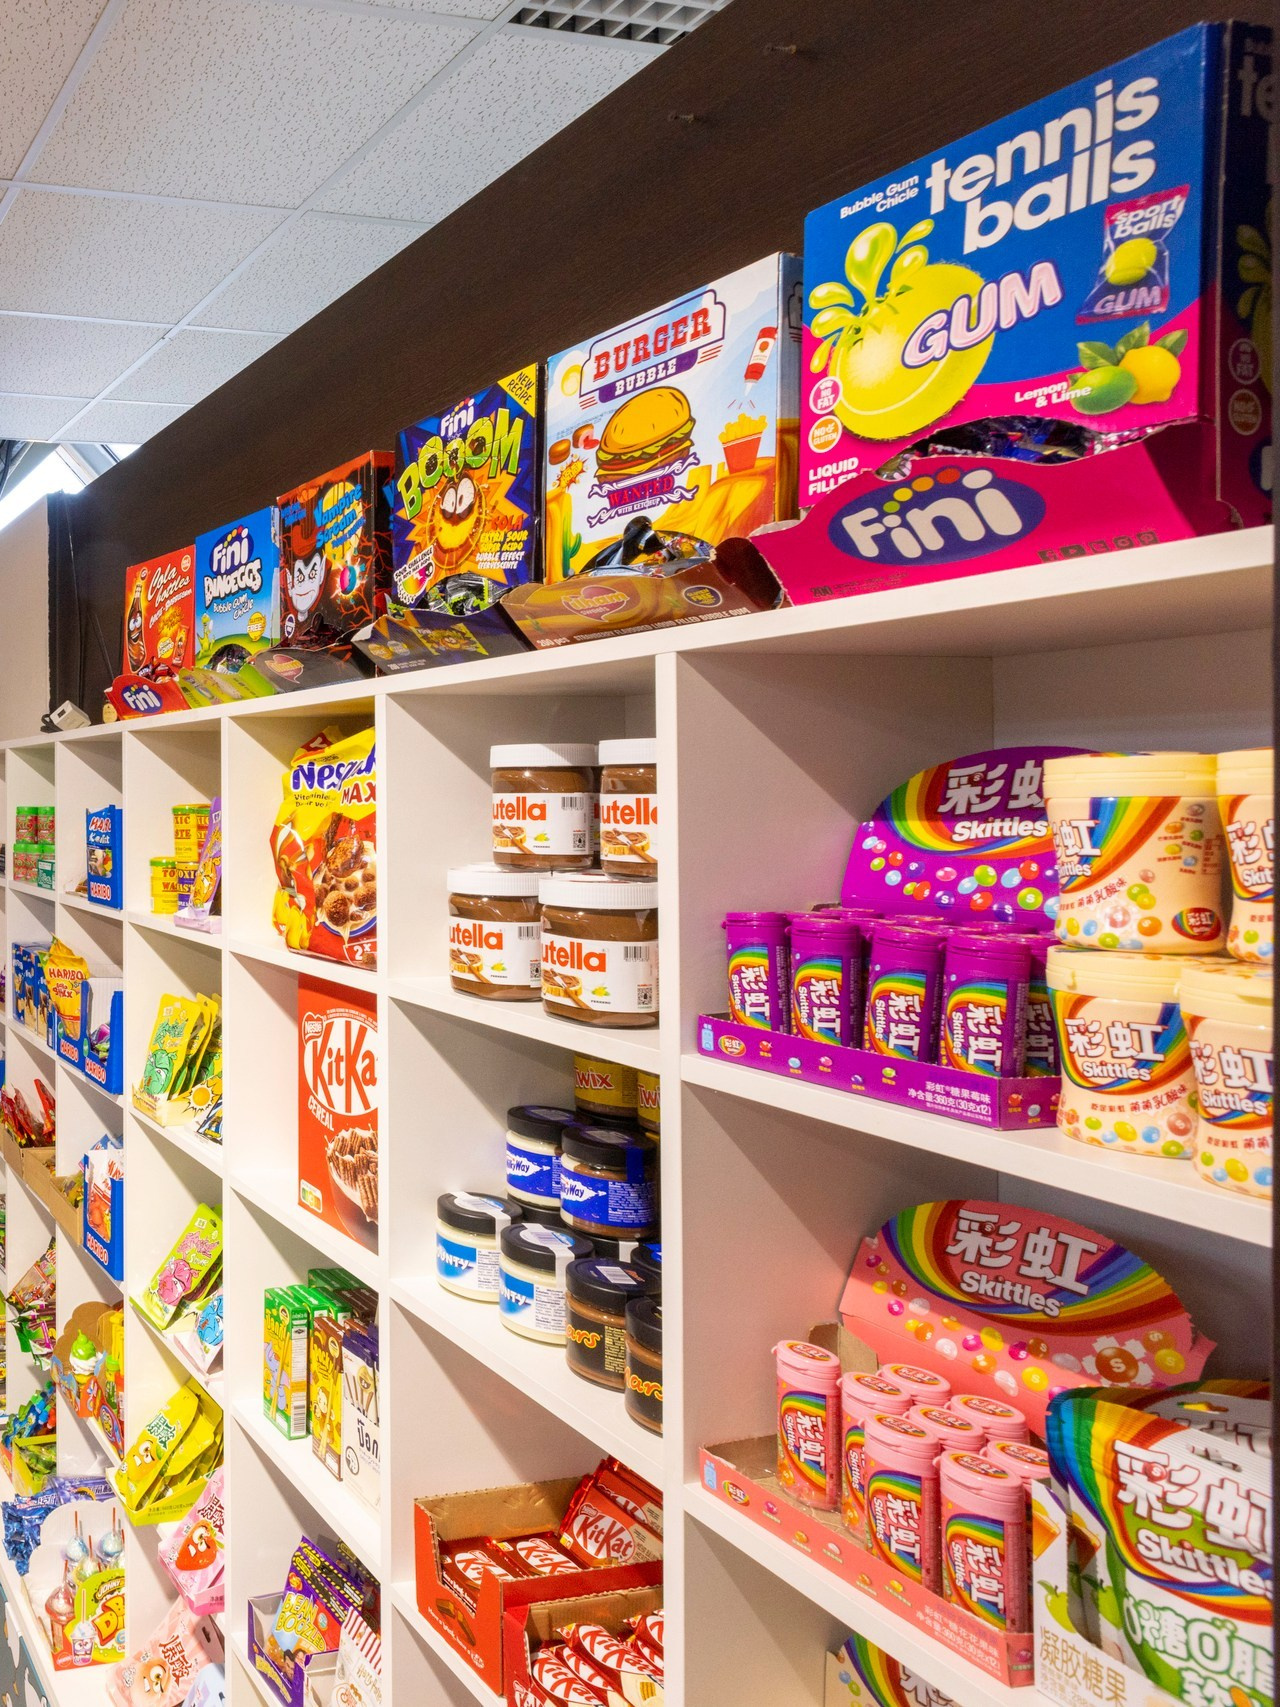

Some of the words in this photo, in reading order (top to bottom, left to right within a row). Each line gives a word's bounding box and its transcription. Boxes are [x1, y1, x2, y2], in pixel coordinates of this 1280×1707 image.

[925, 77, 1160, 215] tennis
[840, 190, 884, 219] Bubble
[886, 174, 919, 199] Gum
[876, 187, 920, 214] Chicle
[963, 140, 1158, 255] balls
[1111, 195, 1185, 226] sport
[1114, 212, 1179, 240] balls
[901, 261, 1064, 368] GUM
[1093, 285, 1161, 315] GUM
[593, 306, 713, 380] BURGER
[507, 380, 532, 405] RECIPE
[516, 370, 534, 391] NEW
[614, 360, 678, 397] BUBBLE
[820, 388, 832, 398] NO
[1014, 381, 1068, 404] Lemon
[1035, 395, 1048, 408] &
[1051, 385, 1092, 405] Lime
[440, 399, 475, 437] Fini
[817, 397, 835, 409] FAT
[813, 433, 838, 446] GLUTEN
[808, 457, 859, 481] LIQUID
[313, 484, 362, 528] Vampire
[607, 475, 676, 508] WANTED
[617, 504, 635, 516] WITH
[316, 509, 357, 548] Scream
[841, 469, 1022, 560] Fini
[213, 526, 249, 574] Fini
[481, 531, 505, 542] EXTRA
[506, 530, 528, 541] SOUR
[394, 564, 407, 579] SOUR
[408, 547, 433, 570] CHALLENGE
[500, 551, 525, 561] EFFECT
[148, 563, 177, 601] Cola
[155, 575, 190, 608] bottles
[247, 623, 263, 633] FREE
[677, 616, 700, 625] FILLED
[700, 610, 730, 622] BUBBLE
[730, 606, 752, 616] GUM
[123, 684, 161, 711] Fini
[492, 796, 546, 822] utella
[953, 817, 1049, 843] Skittles
[90, 881, 111, 901] HARIBO
[449, 922, 503, 950] utella
[1186, 911, 1213, 926] 彩虹
[48, 967, 84, 981] HARIBO
[541, 942, 607, 973] utella
[731, 974, 742, 1011] Skittles
[740, 965, 771, 1018] 彩虹
[798, 985, 809, 1025] Skittles
[810, 977, 842, 1032] 彩虹
[874, 999, 886, 1040] Skittles
[889, 991, 921, 1050] 彩虹
[951, 1011, 963, 1056] Skittles
[966, 1002, 1003, 1068] 彩虹
[60, 1038, 78, 1062] HARIBO
[1064, 1016, 1166, 1062] 彩虹
[85, 1057, 107, 1084] HARIBO
[1082, 1060, 1152, 1081] Skittles
[1189, 1040, 1273, 1094] 彩虹
[307, 1095, 335, 1132] CEREAL
[1201, 1088, 1268, 1115] Skittles
[86, 1232, 109, 1266] HARIBO
[946, 1208, 1100, 1295] 彩虹
[961, 1269, 1063, 1319] Skittles
[785, 1413, 796, 1454] Skittles
[796, 1410, 826, 1470] 彩虹
[849, 1449, 860, 1491] Skittles
[575, 1513, 635, 1558] KitKat
[873, 1496, 885, 1541] Skittles
[886, 1493, 921, 1563] 彩虹
[951, 1541, 964, 1588] Skittles
[966, 1538, 1005, 1611] 彩虹
[283, 1592, 318, 1622] BEAN
[275, 1612, 327, 1652] BOOZLED
[582, 1626, 659, 1678] KitKat
[1040, 1626, 1128, 1705] 凝胶糖果
[534, 1656, 597, 1702] KitKat
